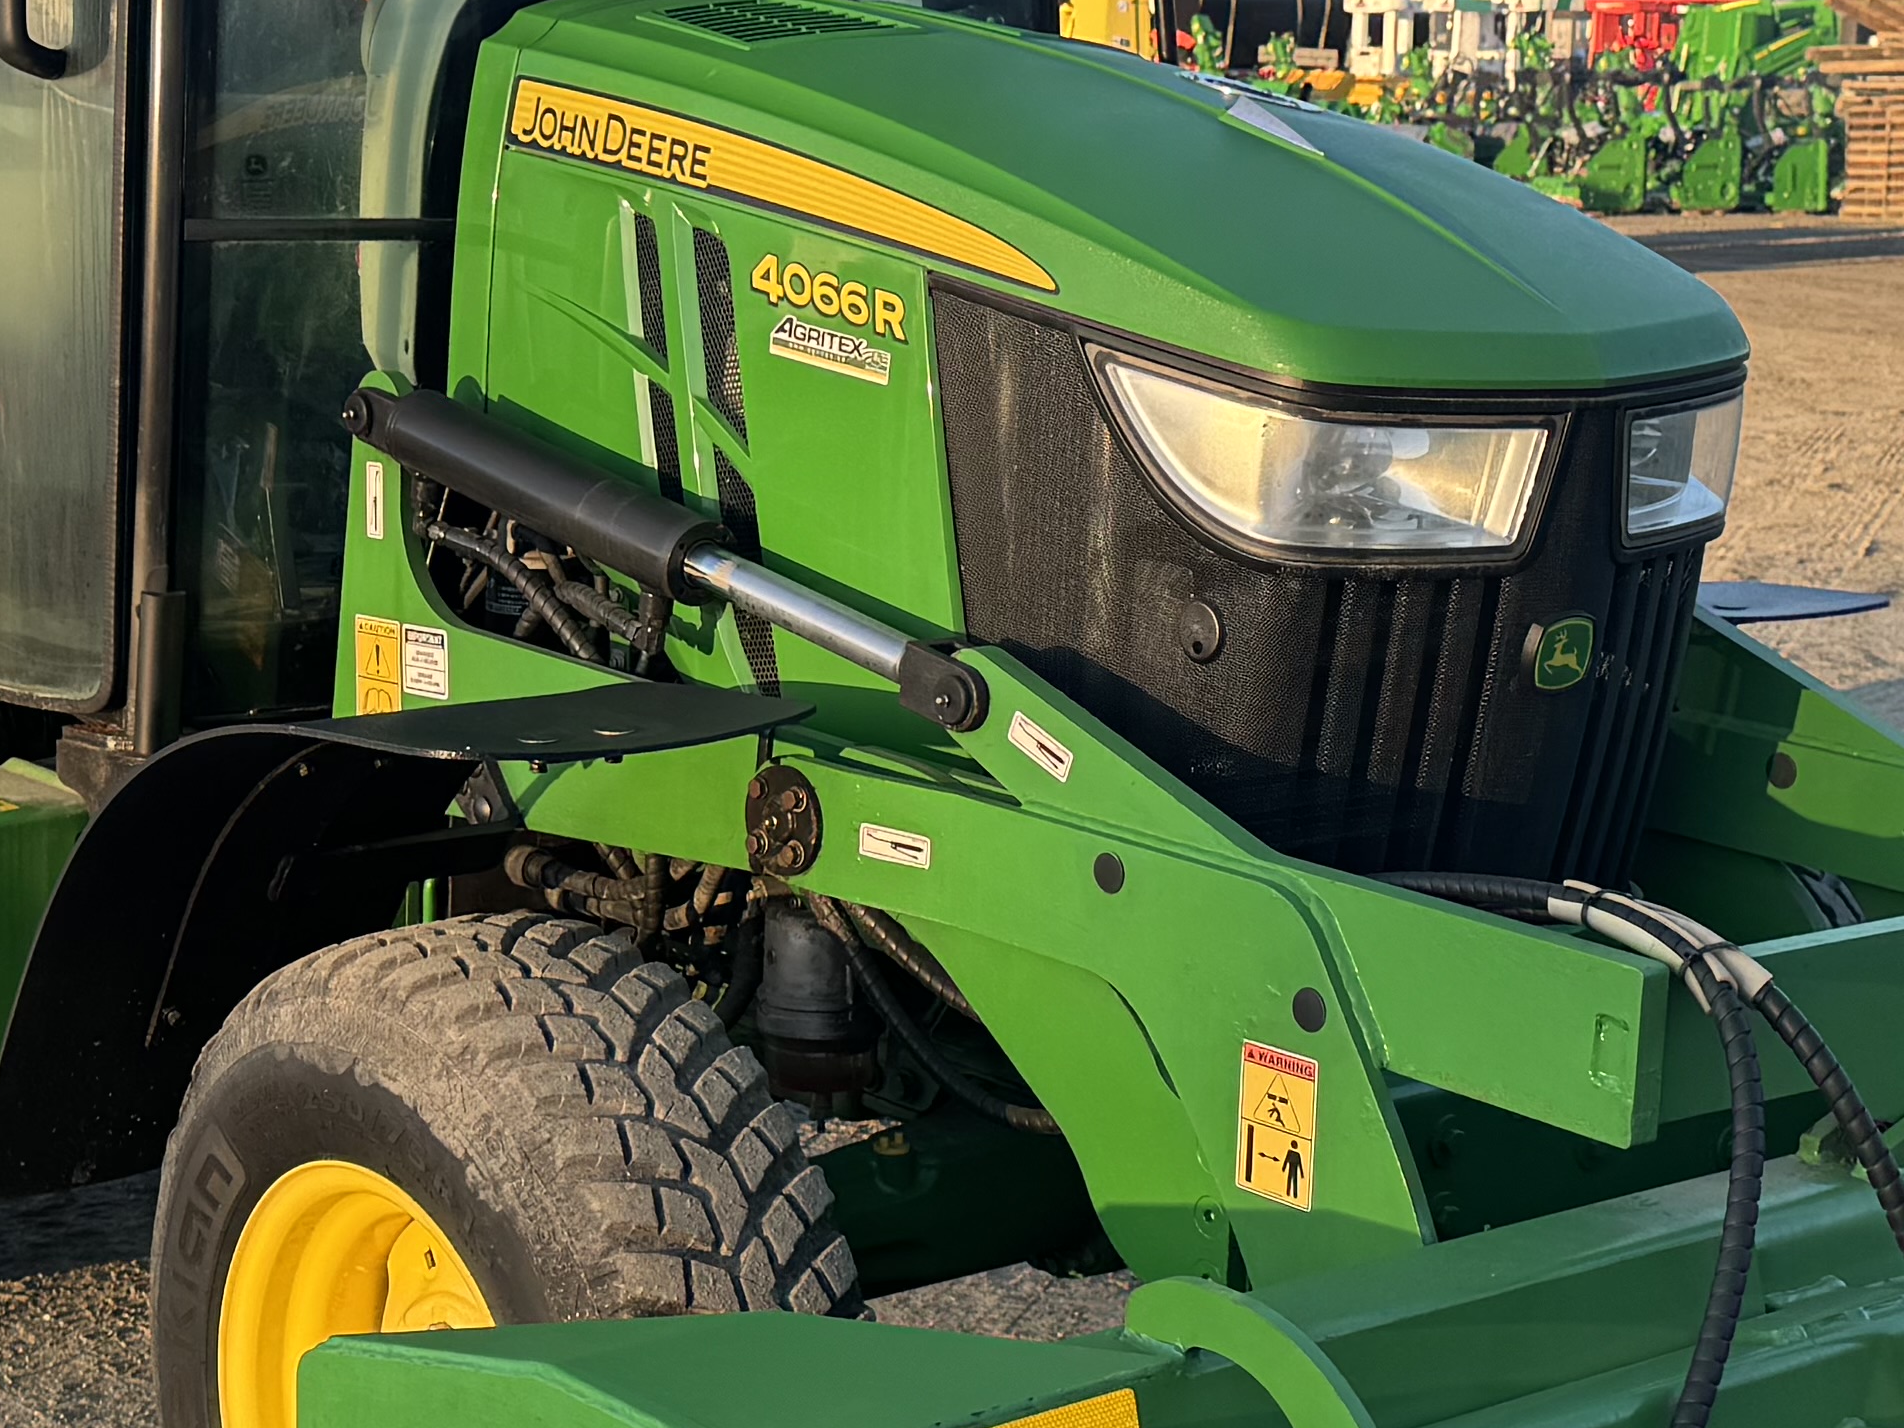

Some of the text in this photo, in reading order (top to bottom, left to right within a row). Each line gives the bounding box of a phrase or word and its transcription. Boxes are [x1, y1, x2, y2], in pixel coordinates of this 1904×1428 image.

[522, 95, 712, 182] JOHN DEERE
[774, 317, 864, 358] AGRITEX
[1257, 1051, 1314, 1079] WARNING
